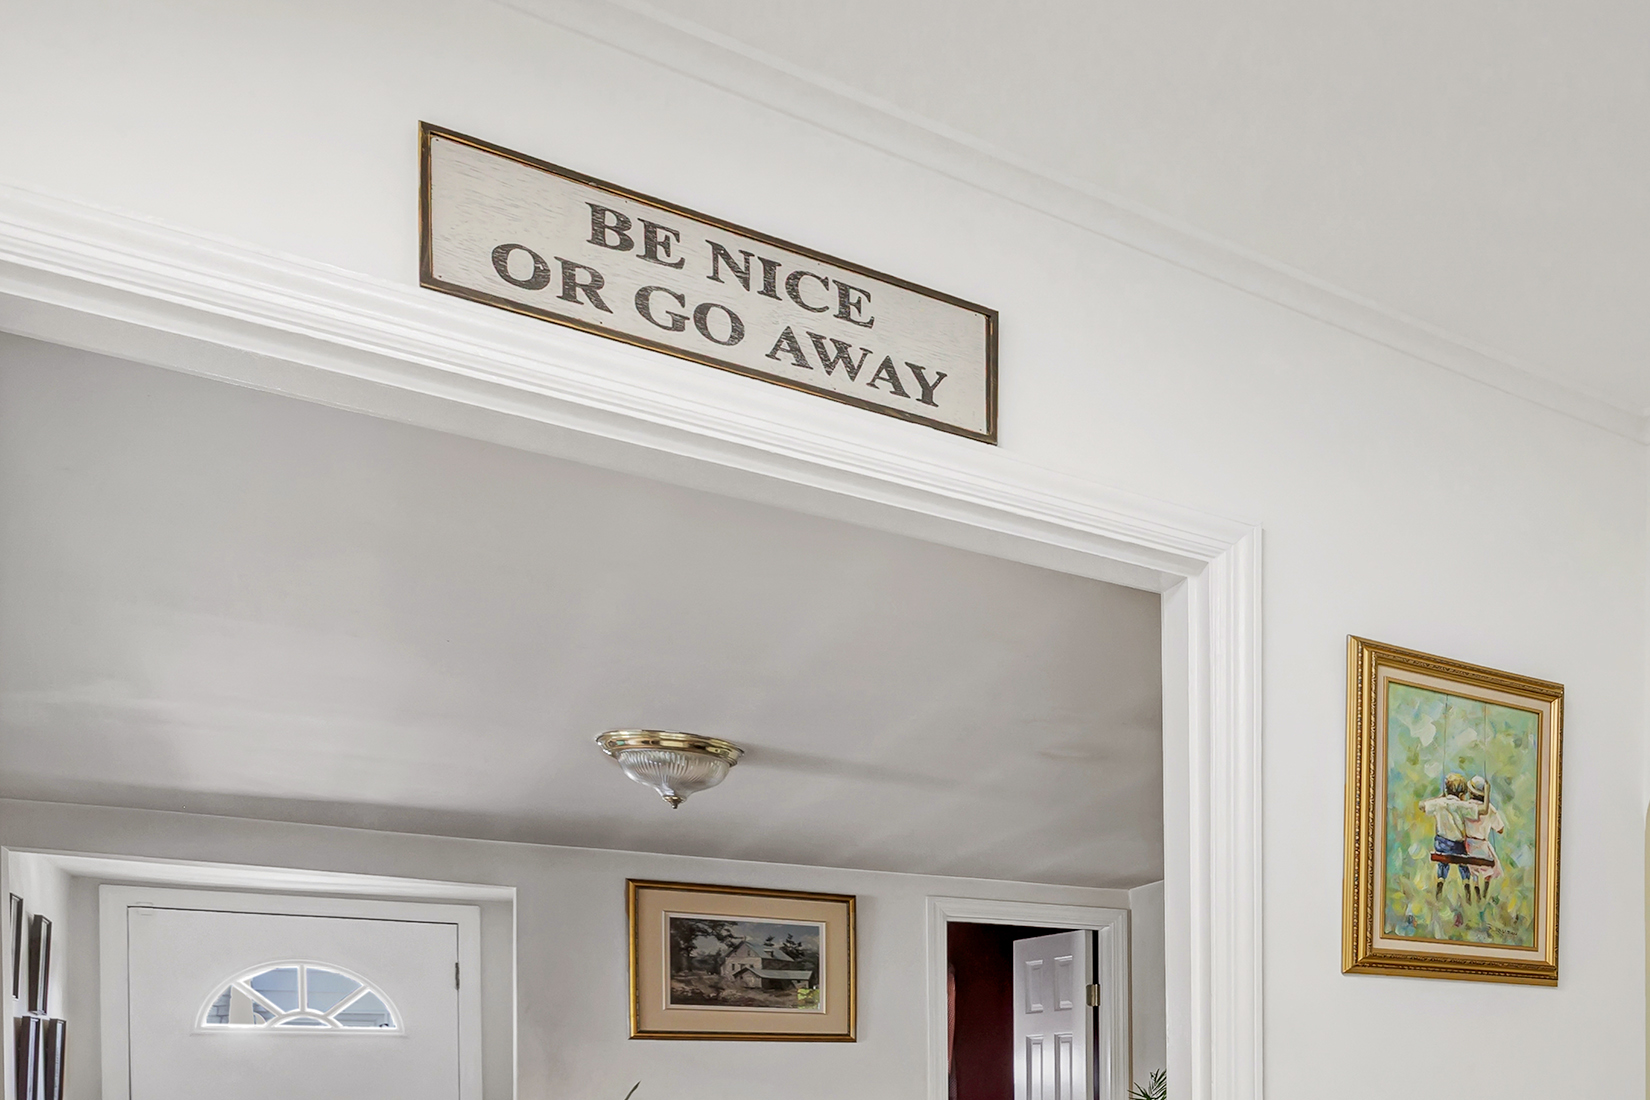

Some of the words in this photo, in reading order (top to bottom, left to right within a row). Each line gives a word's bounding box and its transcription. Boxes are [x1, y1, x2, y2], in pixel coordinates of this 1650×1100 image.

[491, 243, 614, 314] OR
[634, 285, 745, 346] GO
[765, 325, 948, 408] AWAY
[585, 201, 686, 270] BE
[704, 239, 875, 329] NICE
